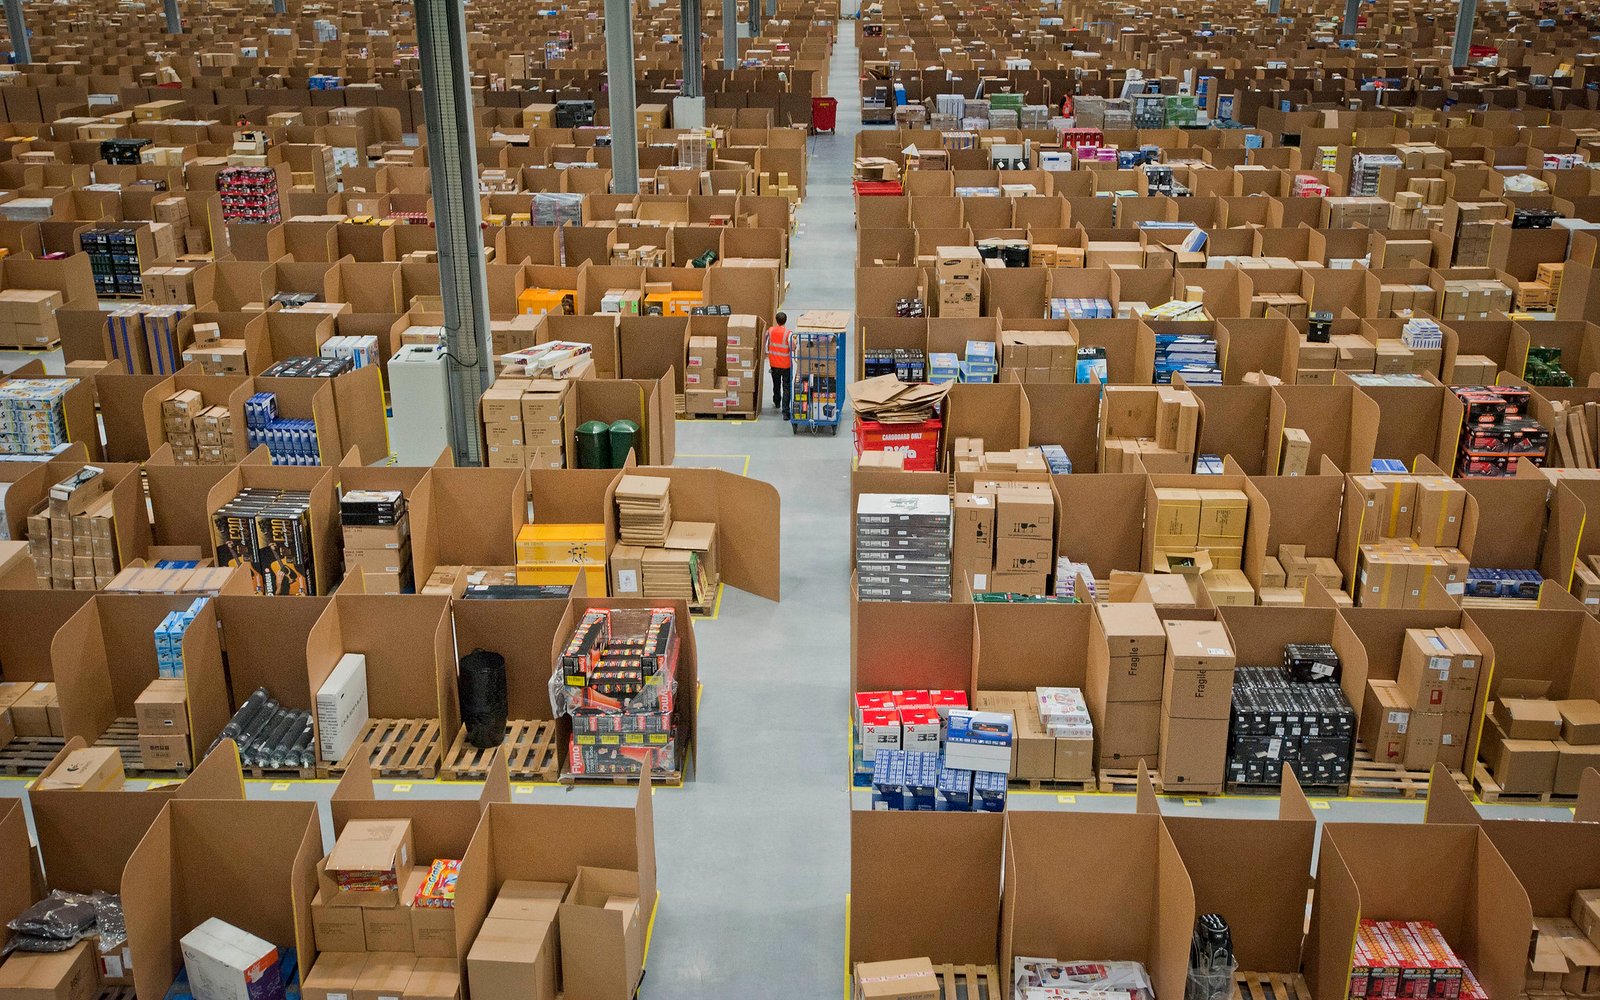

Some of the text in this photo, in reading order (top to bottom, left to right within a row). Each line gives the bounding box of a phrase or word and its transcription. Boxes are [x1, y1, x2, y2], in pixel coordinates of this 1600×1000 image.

[1128, 646, 1140, 676] Fragile
[1195, 669, 1207, 698] Fragile
[572, 745, 583, 774] Flymo
